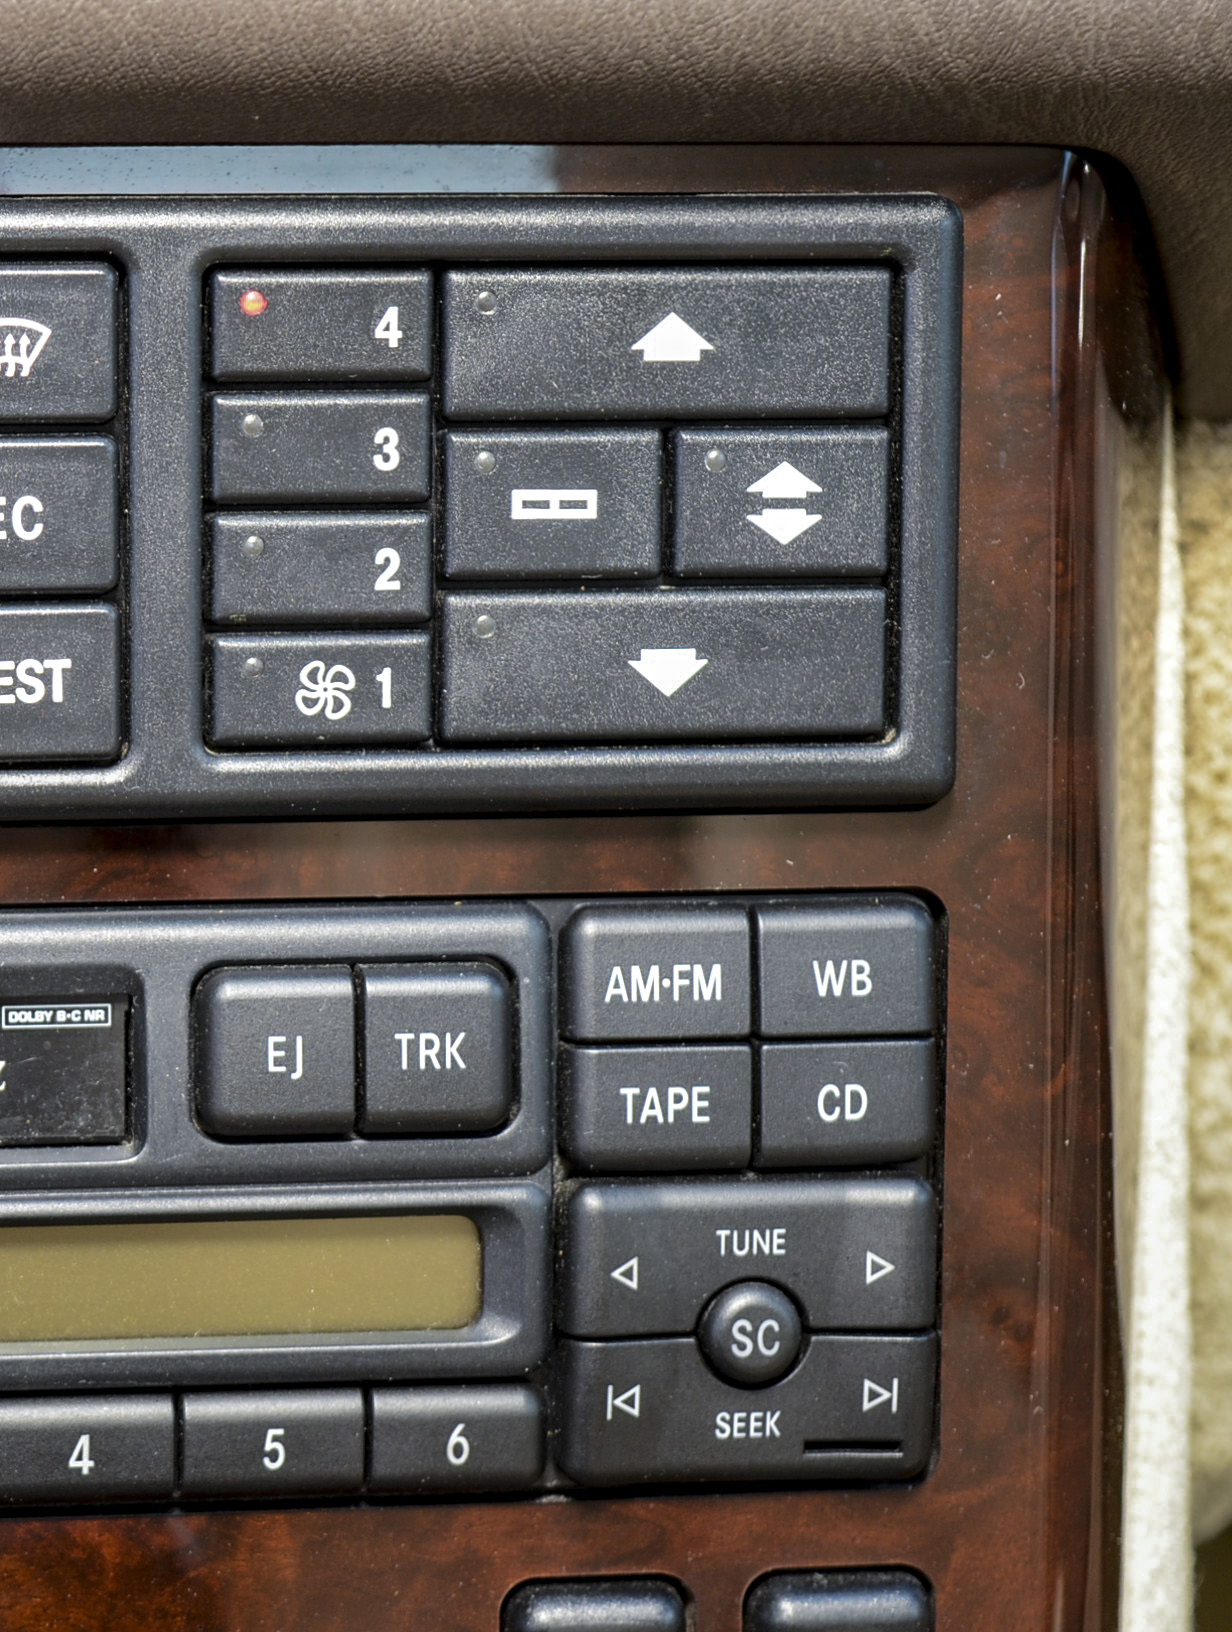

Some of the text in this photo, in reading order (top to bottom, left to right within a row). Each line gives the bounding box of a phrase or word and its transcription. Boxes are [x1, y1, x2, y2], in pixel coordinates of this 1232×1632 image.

[373, 305, 404, 349] 4
[372, 426, 401, 472] 3
[373, 546, 402, 592] 2
[375, 666, 393, 709] 1
[811, 958, 874, 998] WB
[7, 1010, 54, 1024] DOLBY
[83, 1009, 106, 1022] NR
[266, 1034, 305, 1081] EJ
[393, 1030, 468, 1072] TRK
[618, 1084, 712, 1125] TAPE
[815, 1082, 870, 1124] CD
[714, 1227, 788, 1258] TUNE
[729, 1319, 781, 1358] SC
[445, 1422, 471, 1466] 6
[714, 1410, 782, 1441] SEEK
[67, 1433, 96, 1476] 4
[262, 1427, 287, 1471] 5
